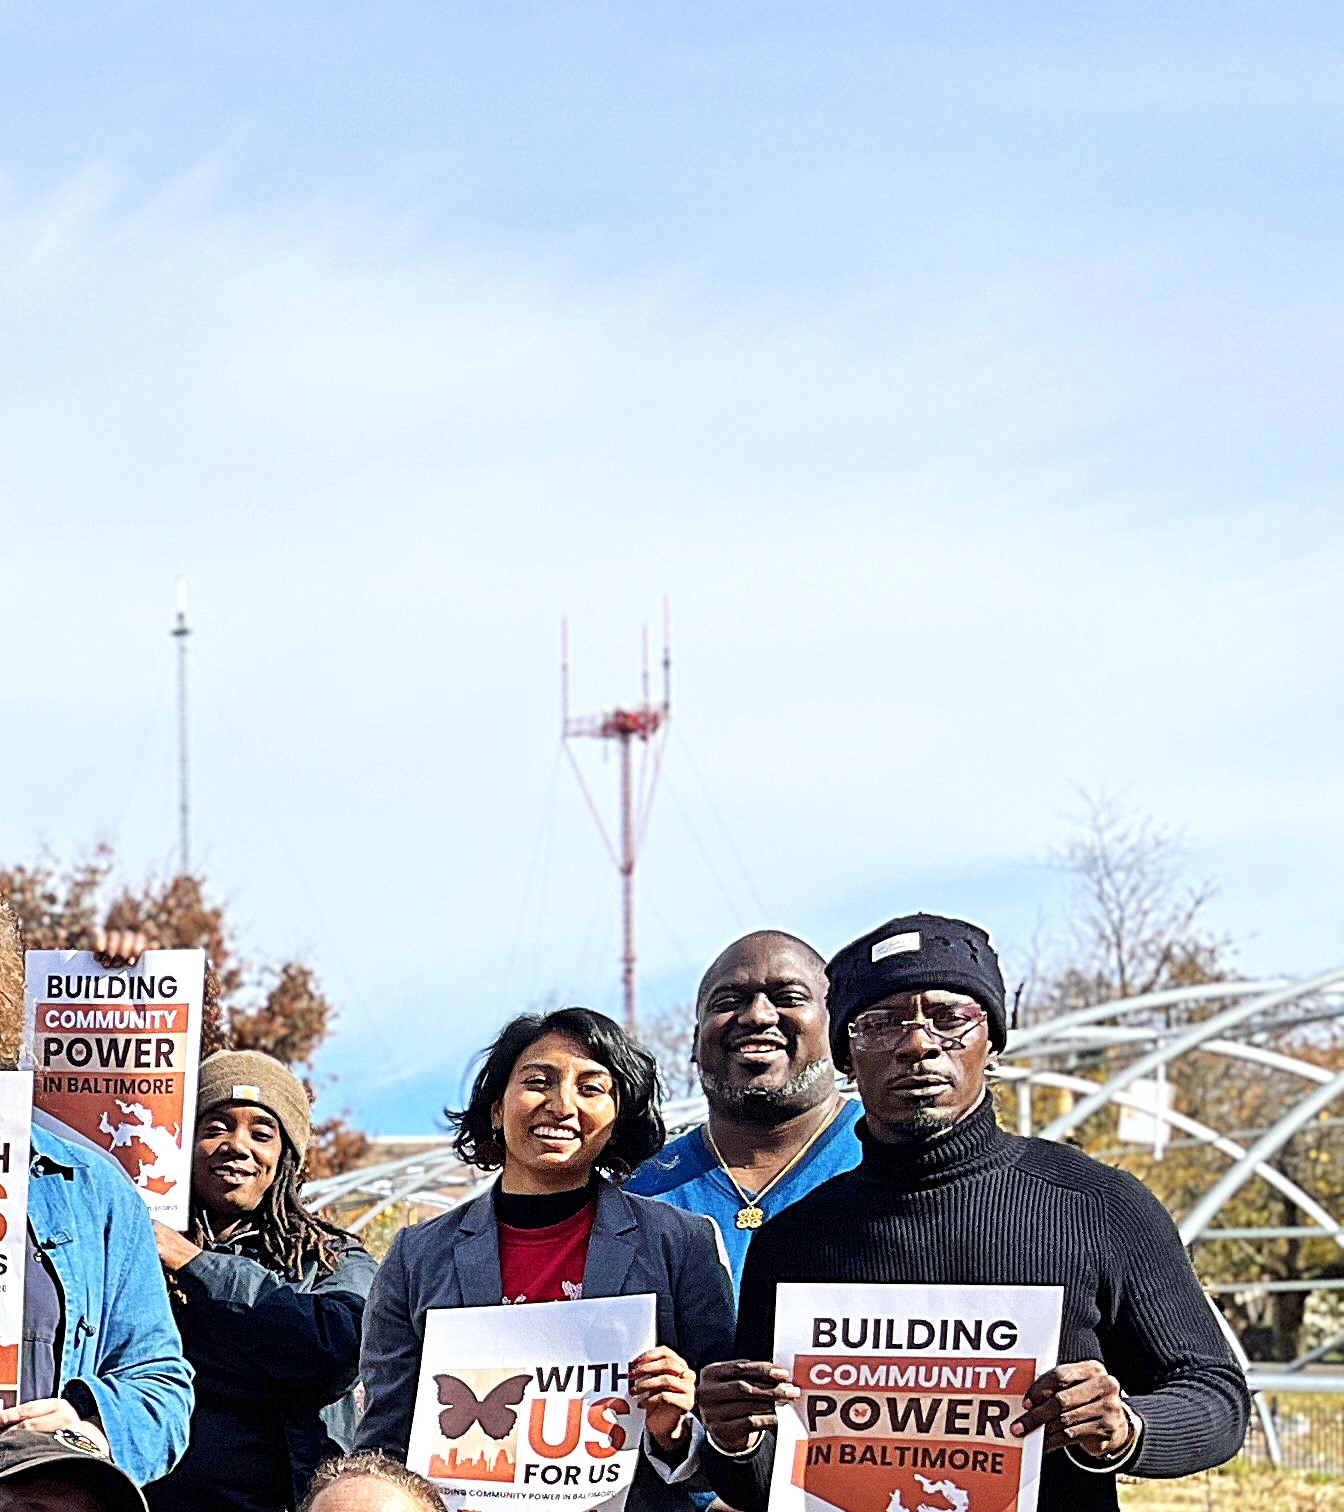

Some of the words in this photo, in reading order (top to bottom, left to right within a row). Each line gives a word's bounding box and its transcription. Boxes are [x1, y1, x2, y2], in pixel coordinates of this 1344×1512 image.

[47, 975, 177, 1000] BUILDING
[45, 1010, 177, 1030] COMMUNITY
[43, 1037, 175, 1069] POWER
[43, 1077, 62, 1093] IN
[68, 1078, 174, 1095] BALTIMORE
[812, 1317, 1018, 1350] BUILDING
[536, 1362, 634, 1393] WITH
[809, 1363, 1017, 1389] COMMUNITY
[528, 1396, 631, 1459] US
[806, 1395, 1011, 1439] POWER
[806, 1444, 831, 1466] IN
[839, 1445, 1004, 1474] BALTIMORE
[524, 1464, 581, 1486] FOR
[589, 1463, 621, 1484] US
[469, 1489, 526, 1500] COMMUNITY
